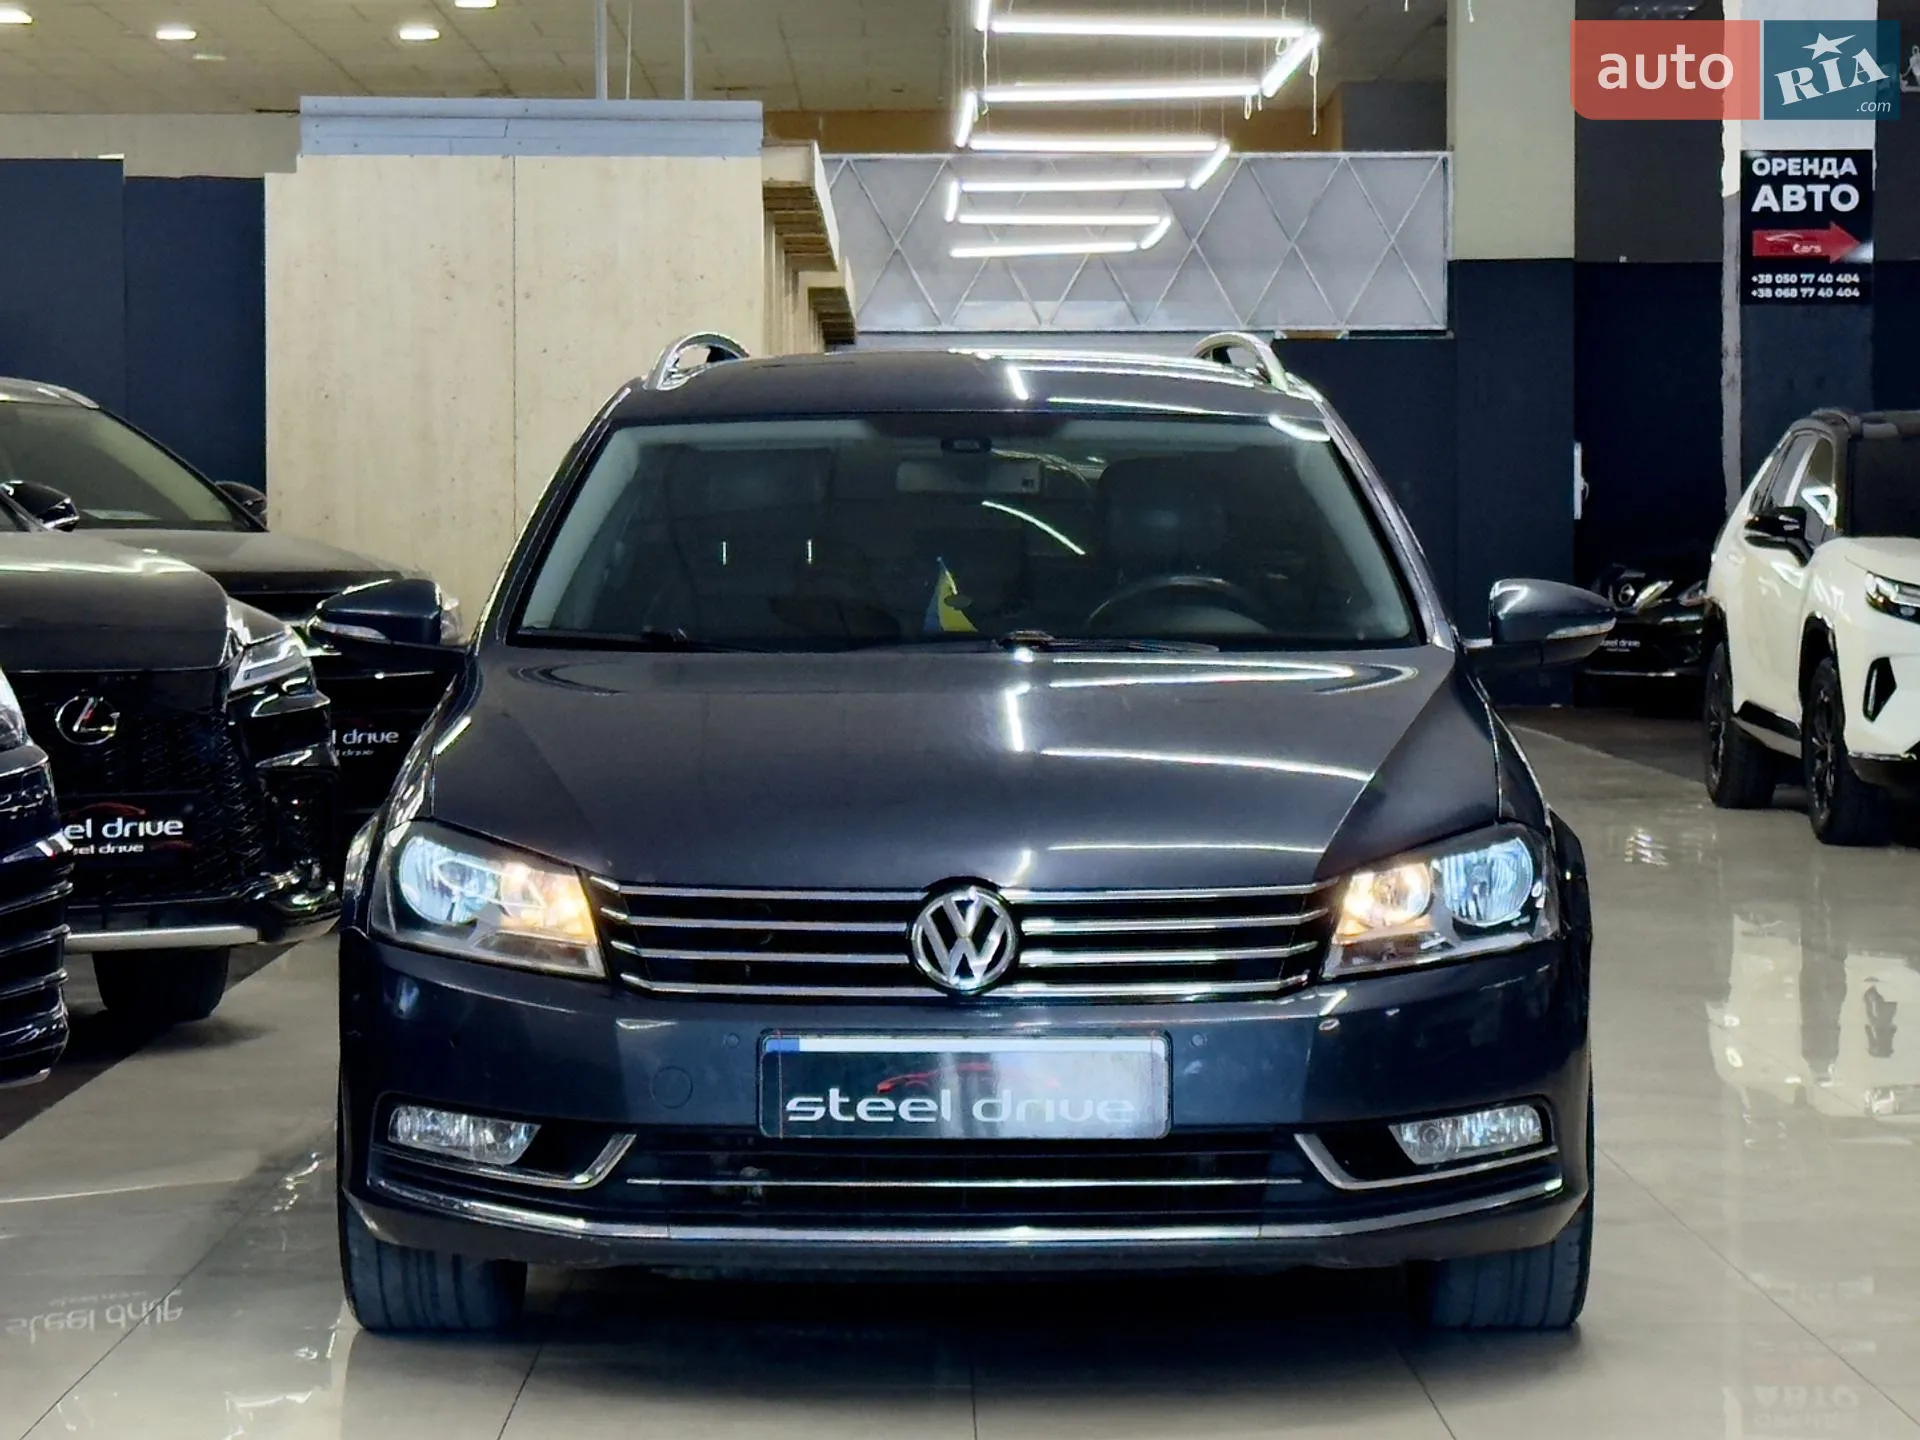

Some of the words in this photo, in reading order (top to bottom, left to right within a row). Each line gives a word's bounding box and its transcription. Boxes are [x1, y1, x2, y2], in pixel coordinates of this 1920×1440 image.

[1752, 157, 1859, 179] ОРЕНДА
[1751, 184, 1860, 212] АВТО
[1751, 273, 1773, 284] +38
[1800, 273, 1816, 284] 77
[1817, 273, 1834, 284] 40
[1835, 273, 1860, 284] 404
[1751, 287, 1773, 298] +38
[1800, 287, 1816, 298] 77
[1817, 287, 1834, 298] 40
[1835, 287, 1860, 298] 404
[343, 728, 399, 745] drive
[102, 817, 184, 839] drive
[99, 842, 145, 854] drive
[786, 1088, 951, 1123] steel
[972, 1089, 1136, 1123] drive
